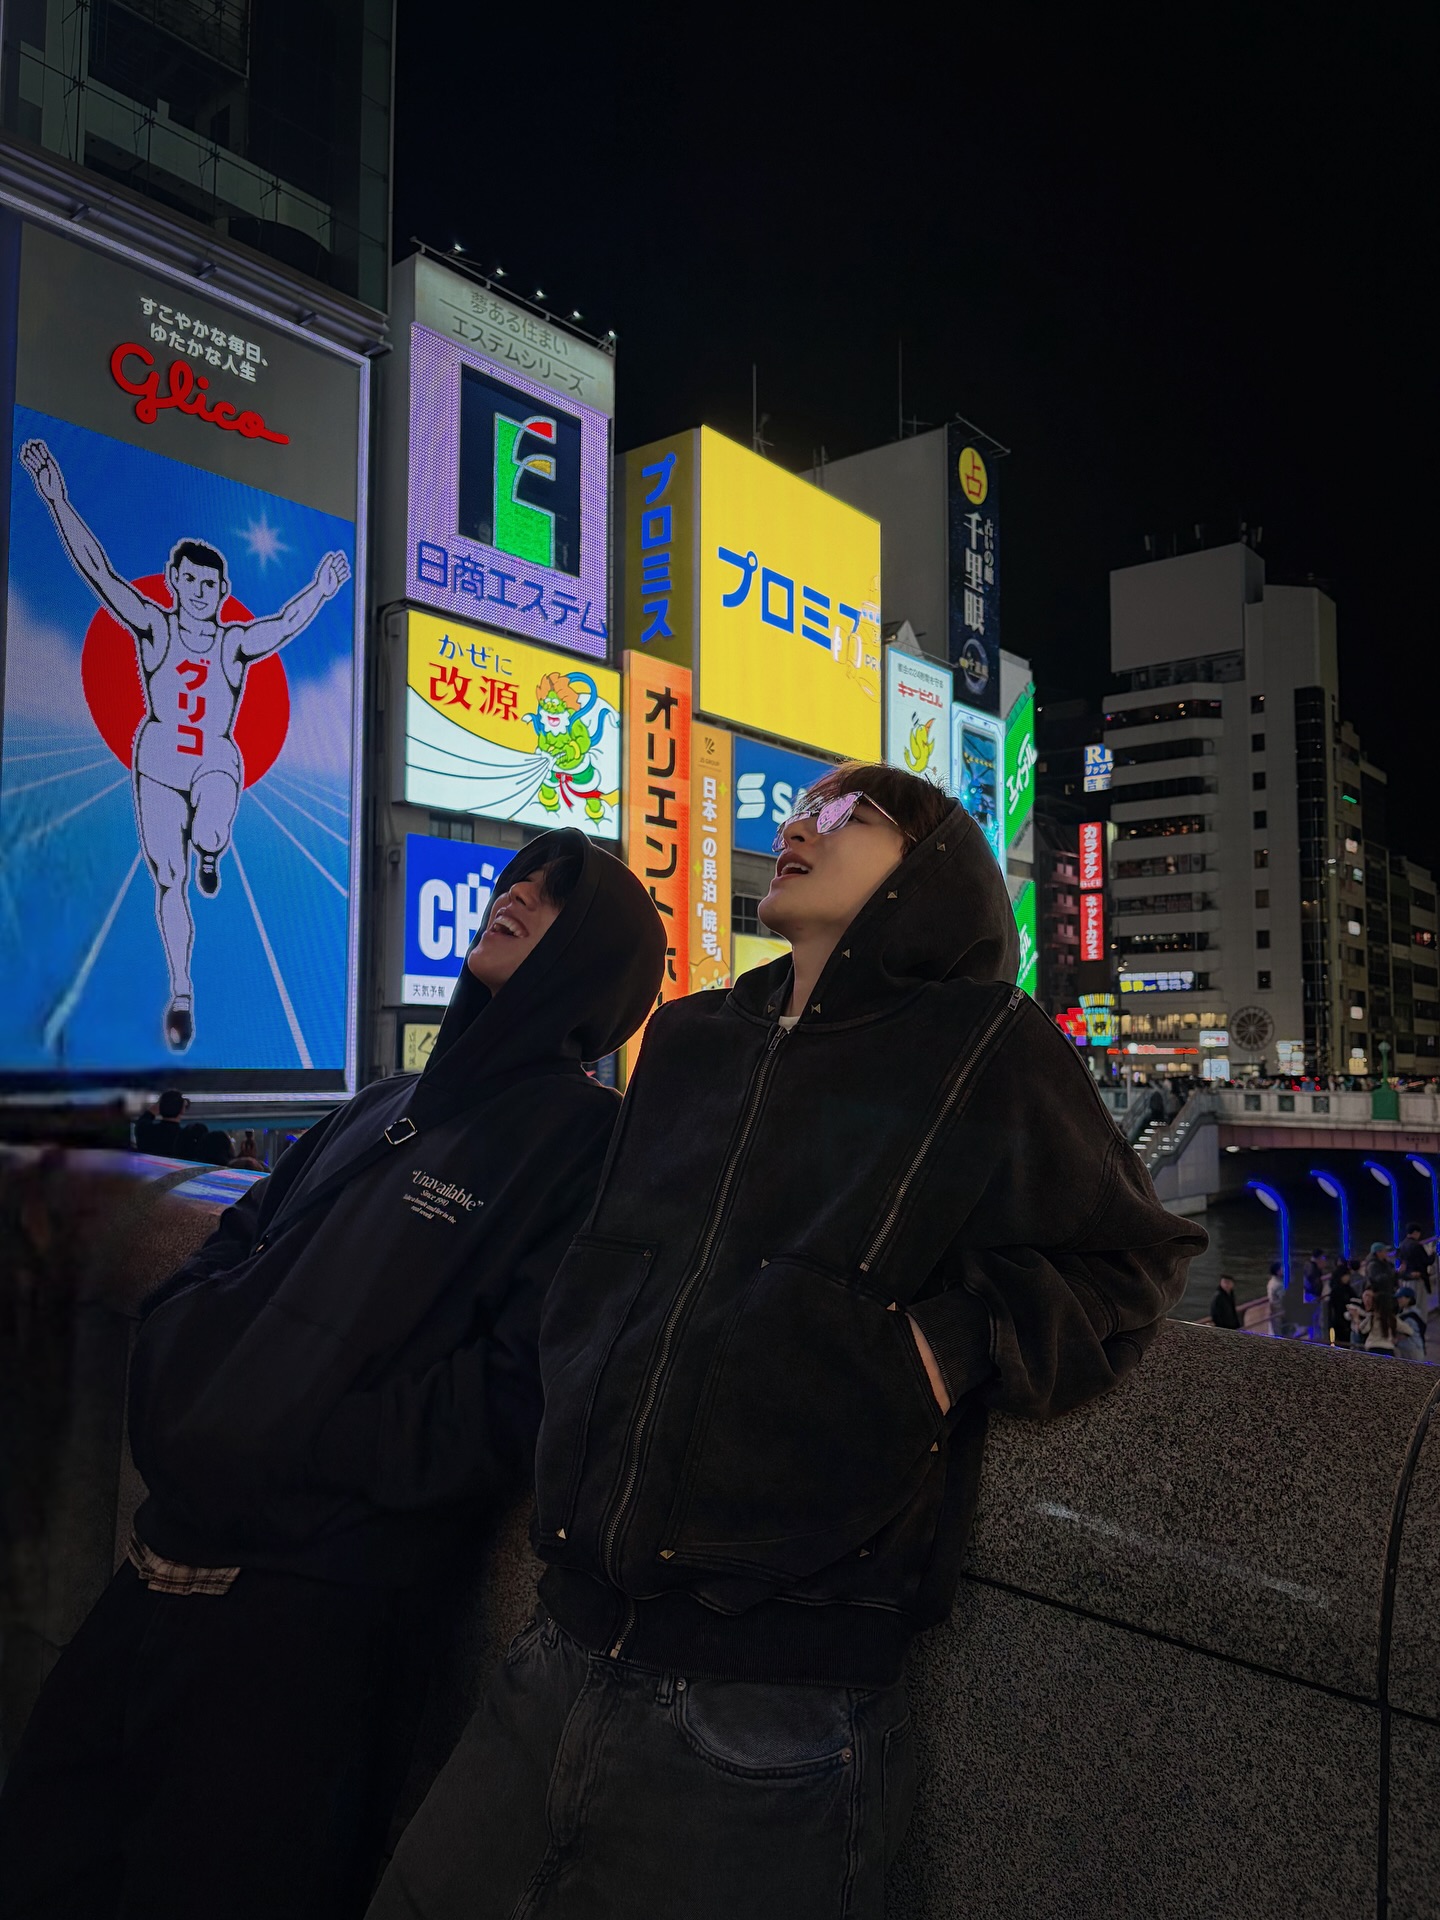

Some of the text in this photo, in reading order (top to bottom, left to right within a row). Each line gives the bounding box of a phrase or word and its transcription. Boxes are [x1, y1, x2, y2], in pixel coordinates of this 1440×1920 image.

[140, 296, 268, 367] すこやかな毎日、
[150, 322, 257, 382] ゆたかな人生
[452, 315, 584, 396] エステムシリーズ
[470, 291, 568, 356] 夢ある住まい
[110, 342, 290, 445] Glico
[965, 451, 983, 498] 占
[641, 452, 676, 643] プロミス
[963, 511, 985, 636] 千里眼
[417, 540, 608, 638] 日商エステム
[438, 633, 513, 676] かぜに
[175, 659, 211, 757] グリコ
[429, 662, 519, 722] 改源
[1083, 824, 1101, 878] カラオケ
[1085, 895, 1100, 960] ネットカフェ
